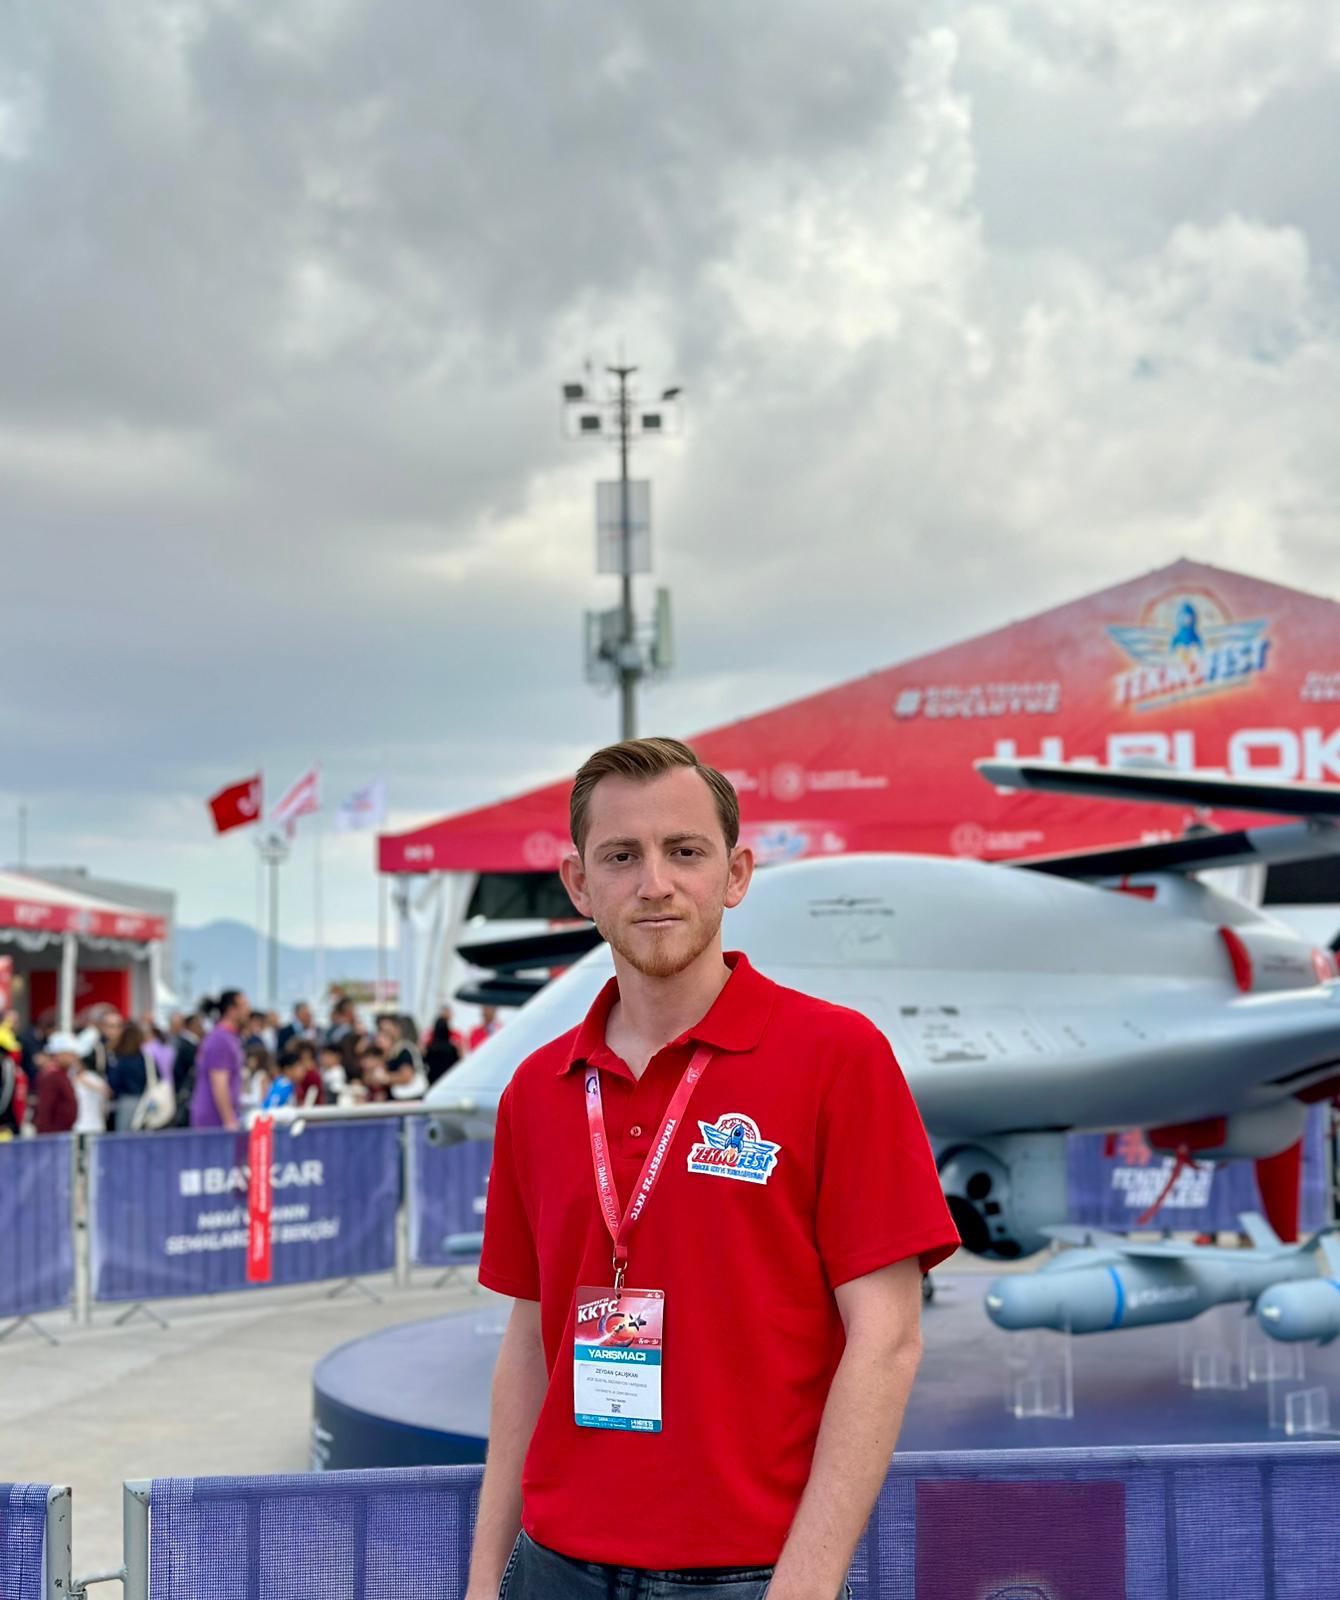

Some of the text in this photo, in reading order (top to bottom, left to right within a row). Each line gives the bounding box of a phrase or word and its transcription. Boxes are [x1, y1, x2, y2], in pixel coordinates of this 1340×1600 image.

[630, 1118, 677, 1221] TEKNOFEST'25 KKTC
[692, 1146, 773, 1171] TEKNOFEST
[577, 1300, 619, 1324] KKTC
[588, 1348, 646, 1362] YARIŞMACI
